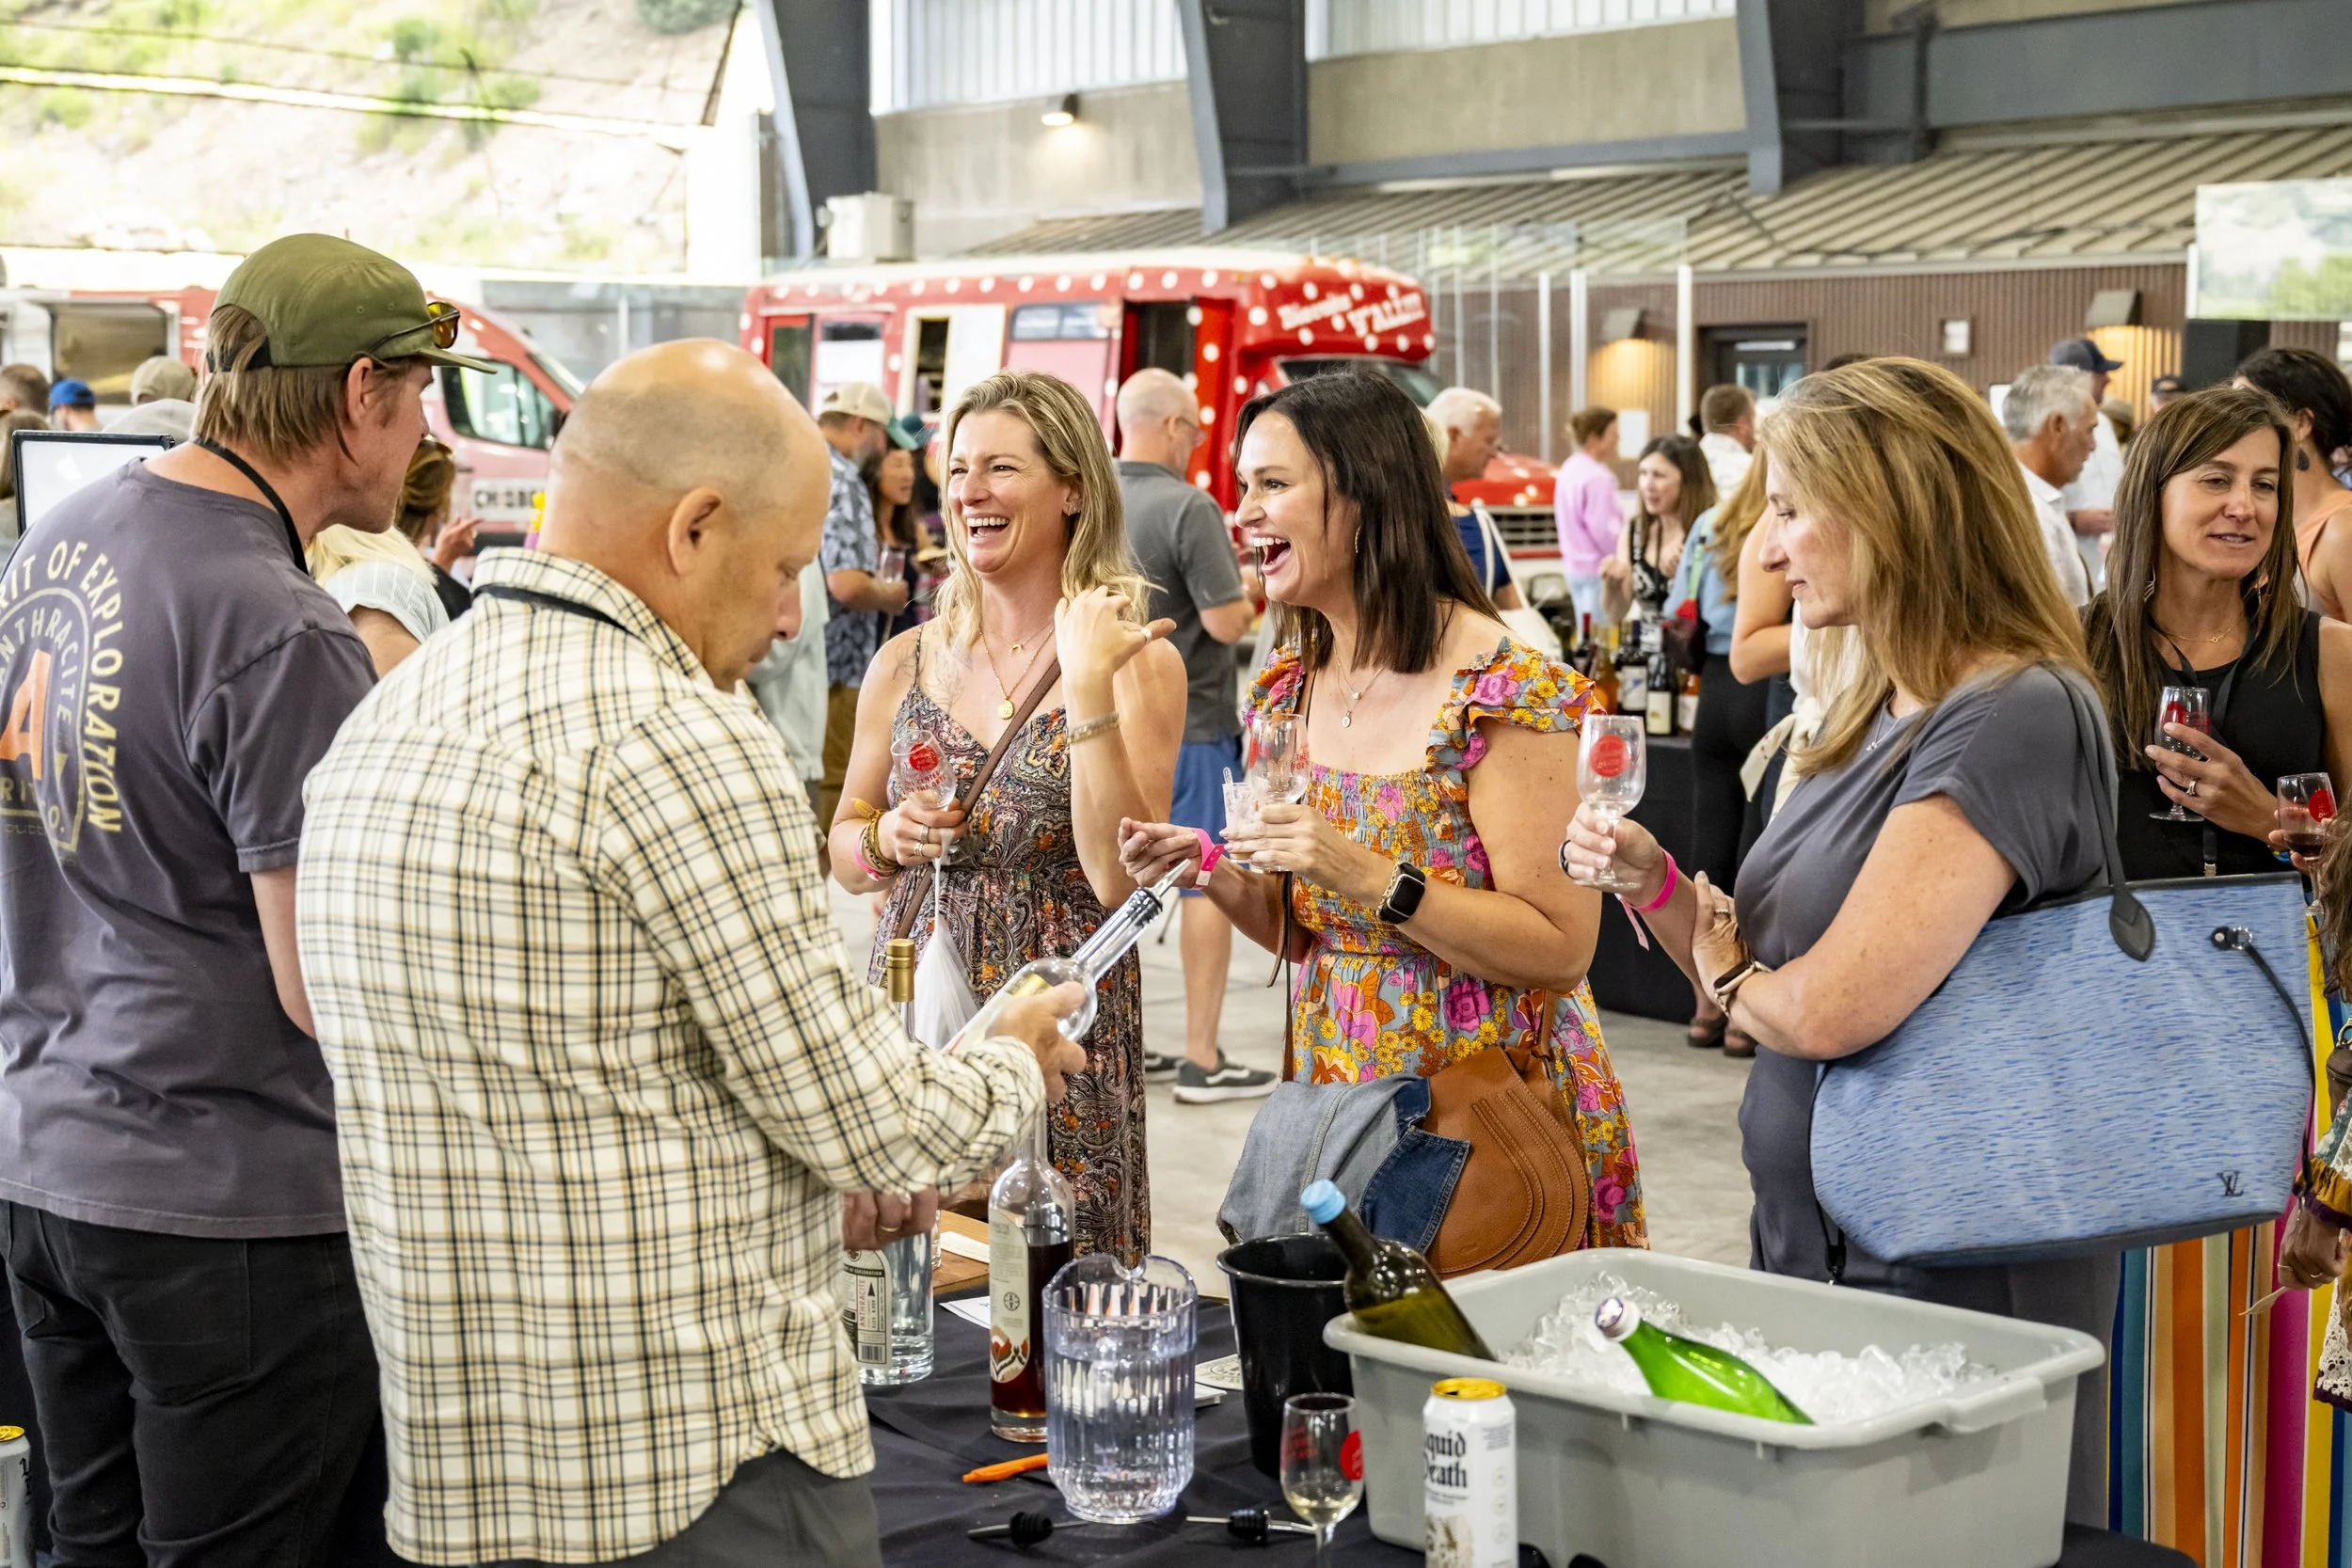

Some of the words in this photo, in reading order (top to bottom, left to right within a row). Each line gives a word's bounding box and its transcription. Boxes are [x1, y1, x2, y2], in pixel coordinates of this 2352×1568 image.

[0, 607, 79, 725] NTHRACITE
[47, 540, 87, 580] OF
[79, 553, 123, 832] EXPLORATION
[858, 1278, 866, 1327] ANTHRACITE
[1424, 1431, 1467, 1461] quid
